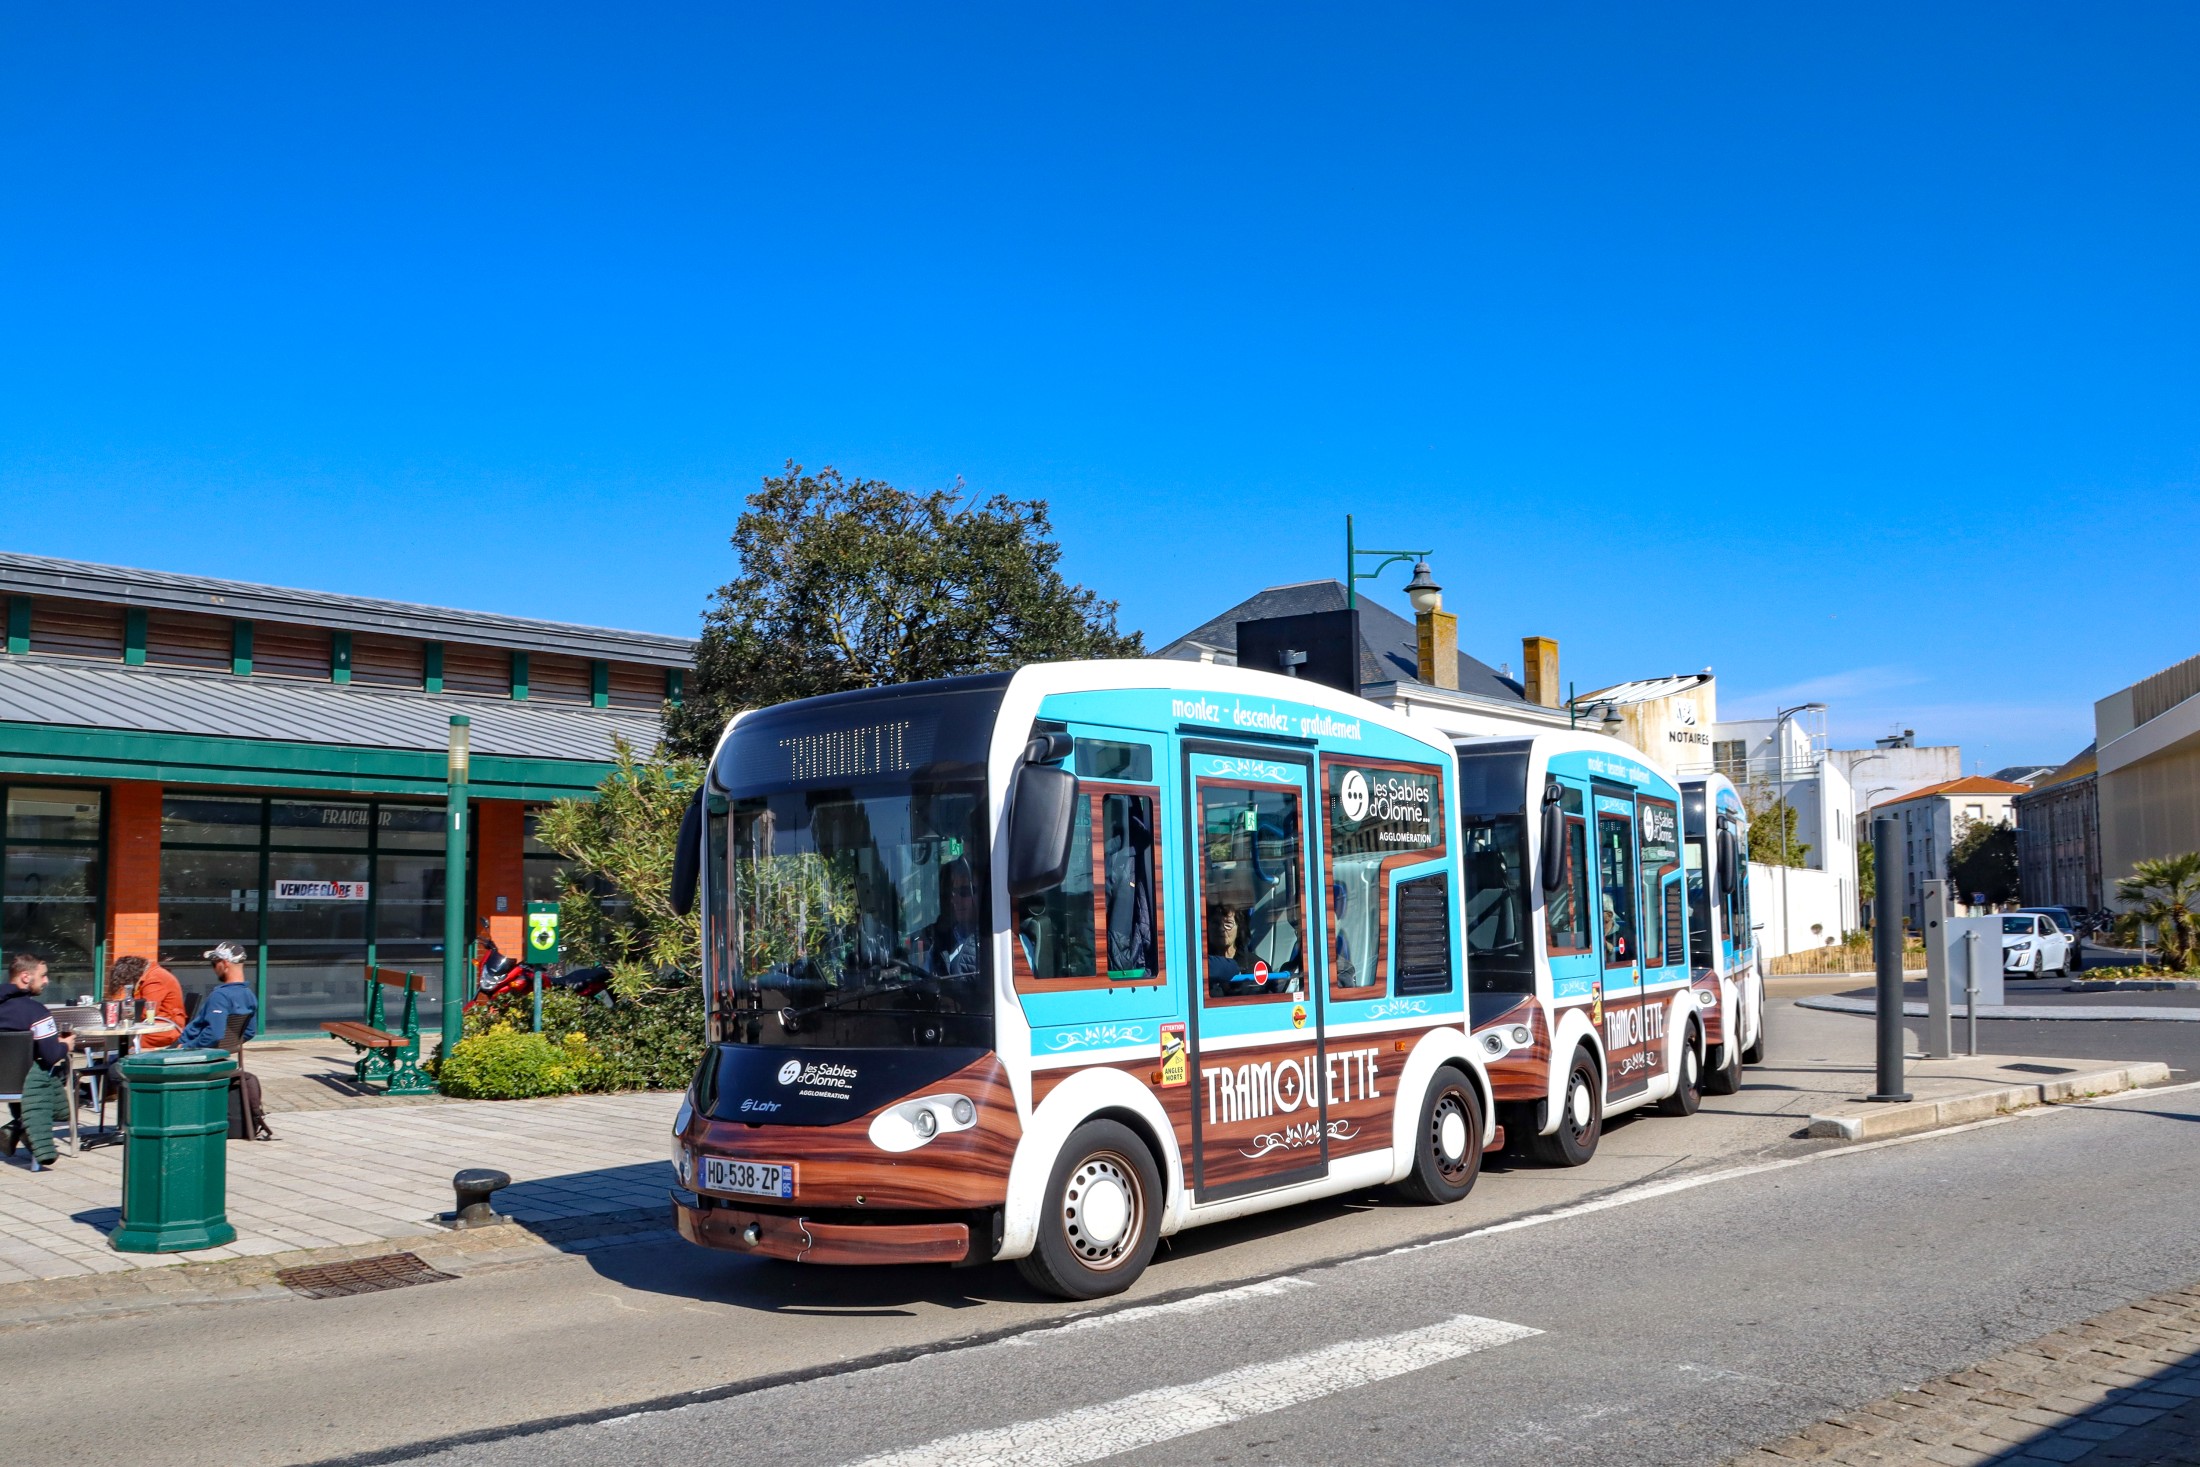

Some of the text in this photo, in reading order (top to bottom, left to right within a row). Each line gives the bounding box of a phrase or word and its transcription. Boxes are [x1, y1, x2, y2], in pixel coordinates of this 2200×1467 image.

[1172, 697, 1220, 723] montez
[1233, 699, 1289, 731] descendez
[1301, 712, 1362, 741] gratuitement
[1669, 731, 1709, 746] NOTAIRES
[1373, 776, 1430, 803] les Sables
[321, 809, 392, 826] FRAICHUR
[1379, 832, 1432, 844] AGGLOMÉRATION
[280, 883, 319, 897] VENDÉE
[320, 881, 351, 898] GLOBE
[1604, 1002, 1664, 1051] TRAMOUETTE
[805, 1062, 858, 1078] les Sables
[1164, 1067, 1184, 1075] ANGLES
[1165, 1074, 1183, 1082] MORTS
[799, 1089, 850, 1100] AGGLOMÉRATION
[1201, 1048, 1380, 1124] TRAMOUETTE
[708, 1161, 780, 1190] HD-538-ZP
[782, 1182, 792, 1194] 85
